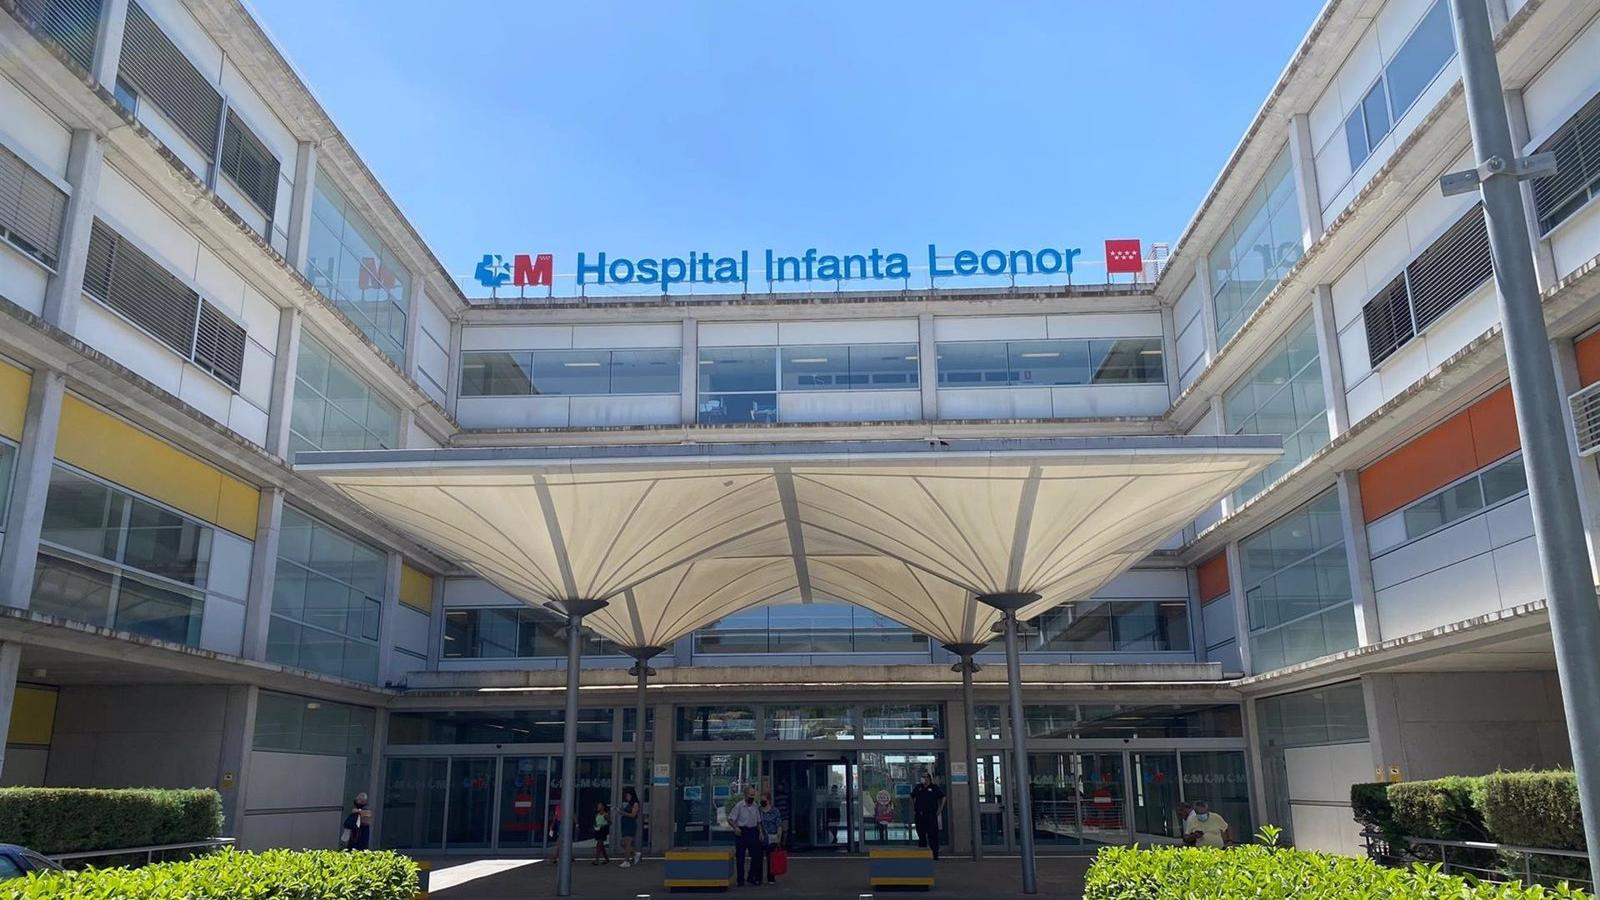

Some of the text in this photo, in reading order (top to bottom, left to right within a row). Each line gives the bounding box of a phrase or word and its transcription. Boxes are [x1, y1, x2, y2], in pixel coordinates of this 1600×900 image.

[513, 243, 1081, 292] M Hospital Infanta Leonor
